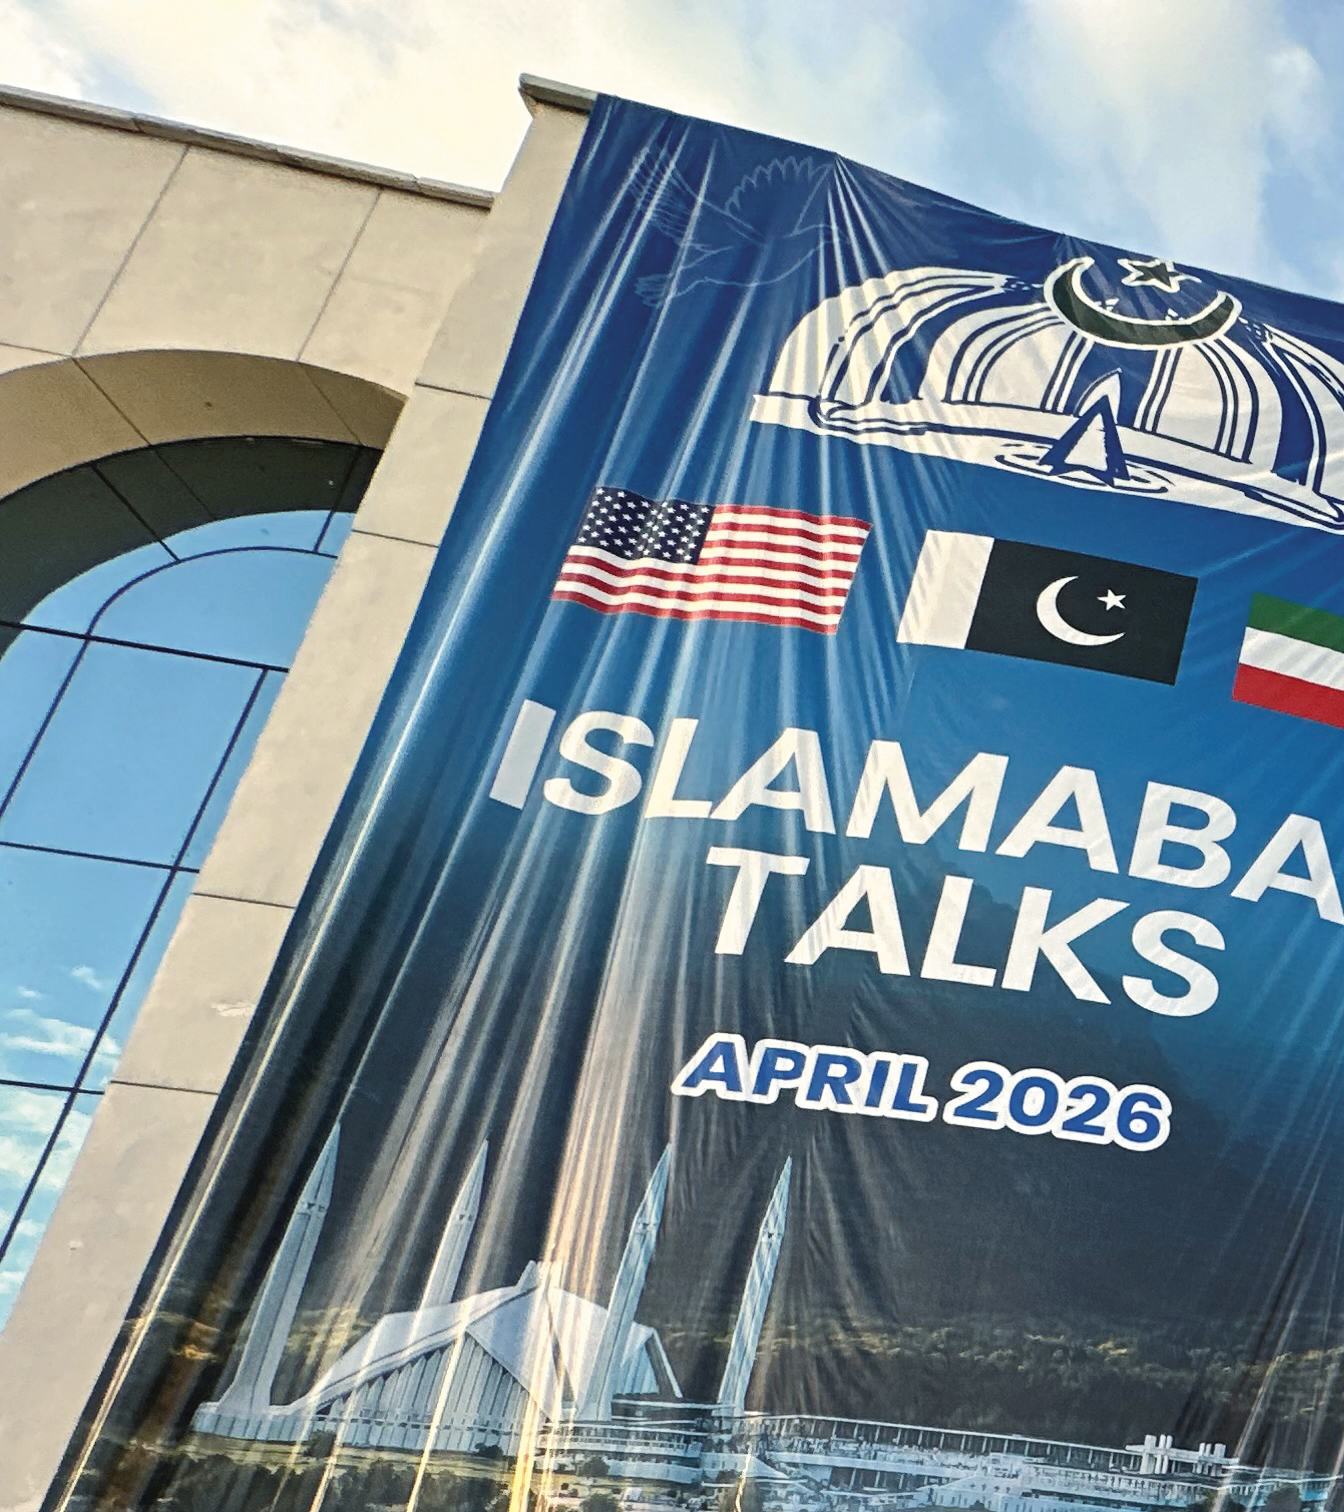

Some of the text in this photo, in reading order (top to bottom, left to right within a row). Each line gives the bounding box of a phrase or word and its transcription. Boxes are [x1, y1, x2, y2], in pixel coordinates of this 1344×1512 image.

[705, 846, 1227, 1017] TALKS
[669, 1032, 1173, 1151] APRIL 2026
